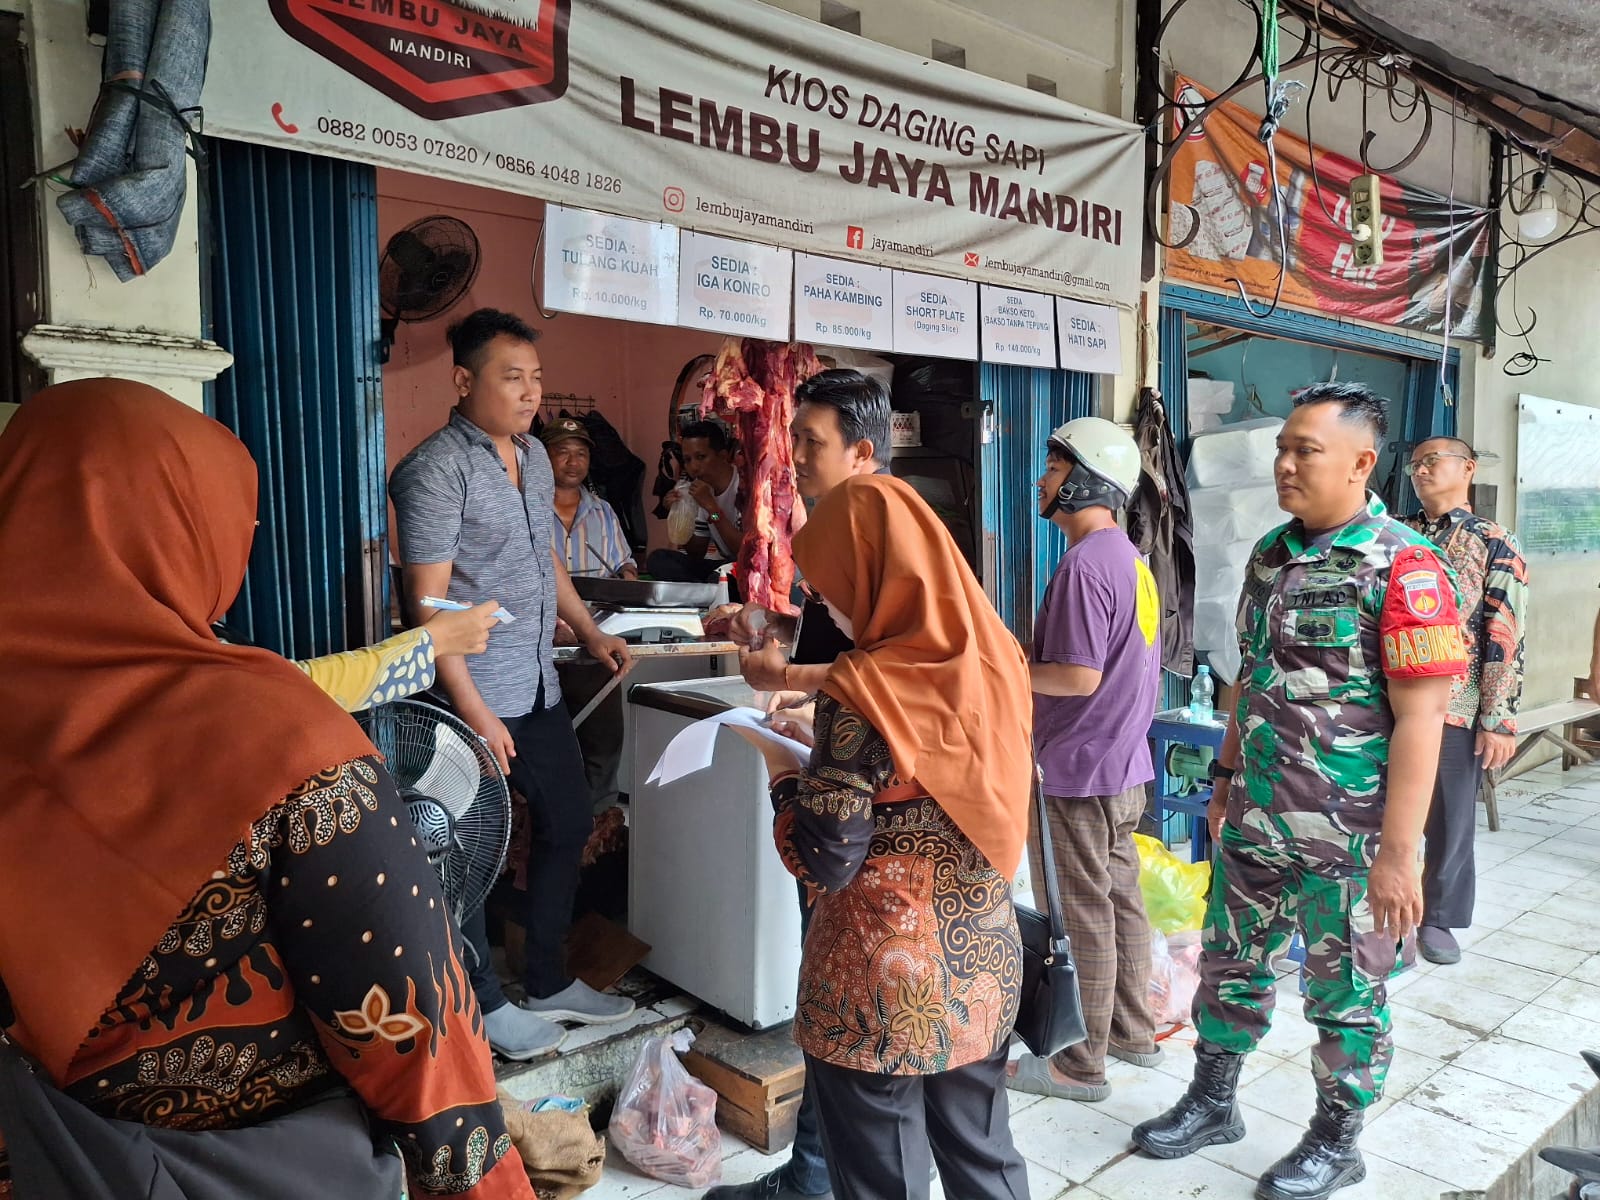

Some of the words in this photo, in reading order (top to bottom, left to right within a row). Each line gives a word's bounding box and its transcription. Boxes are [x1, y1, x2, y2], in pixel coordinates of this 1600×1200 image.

[454, 16, 523, 52] JAYA
[390, 37, 471, 69] MANDIRI
[764, 64, 850, 120] KIOS
[858, 93, 976, 156] DAGING
[984, 135, 1046, 175] SAPI
[317, 116, 366, 140] 0882
[372, 127, 418, 151] 0053
[423, 138, 478, 163] 07820
[495, 154, 535, 176] 0856
[540, 164, 580, 185] 4048
[586, 172, 622, 193] 1826
[620, 76, 820, 173] LEMBU
[839, 141, 955, 207] JAYA
[968, 170, 1122, 246] MANDIRI
[696, 197, 815, 236] lembujayamandiri
[870, 235, 935, 259] jayamandiri
[621, 260, 659, 277] KUAH
[984, 256, 1110, 292] lembujayamandiri@gmail.com
[697, 273, 720, 290] IGA
[723, 278, 771, 298] KONRO
[804, 285, 832, 300] PAHA
[834, 290, 883, 308] KAMBING
[595, 292, 648, 311] 10.000/kg
[998, 306, 1019, 316] BAKSO
[699, 306, 716, 320] Rp.
[719, 310, 767, 328] 70.000/kg
[906, 305, 937, 319] SHORT
[939, 309, 966, 323] PLATE
[1006, 318, 1025, 328] TANPA
[832, 324, 872, 341] 85.000/kg
[1067, 333, 1086, 347] HATI
[1087, 336, 1107, 350] SAPI
[1293, 591, 1316, 606] TNI
